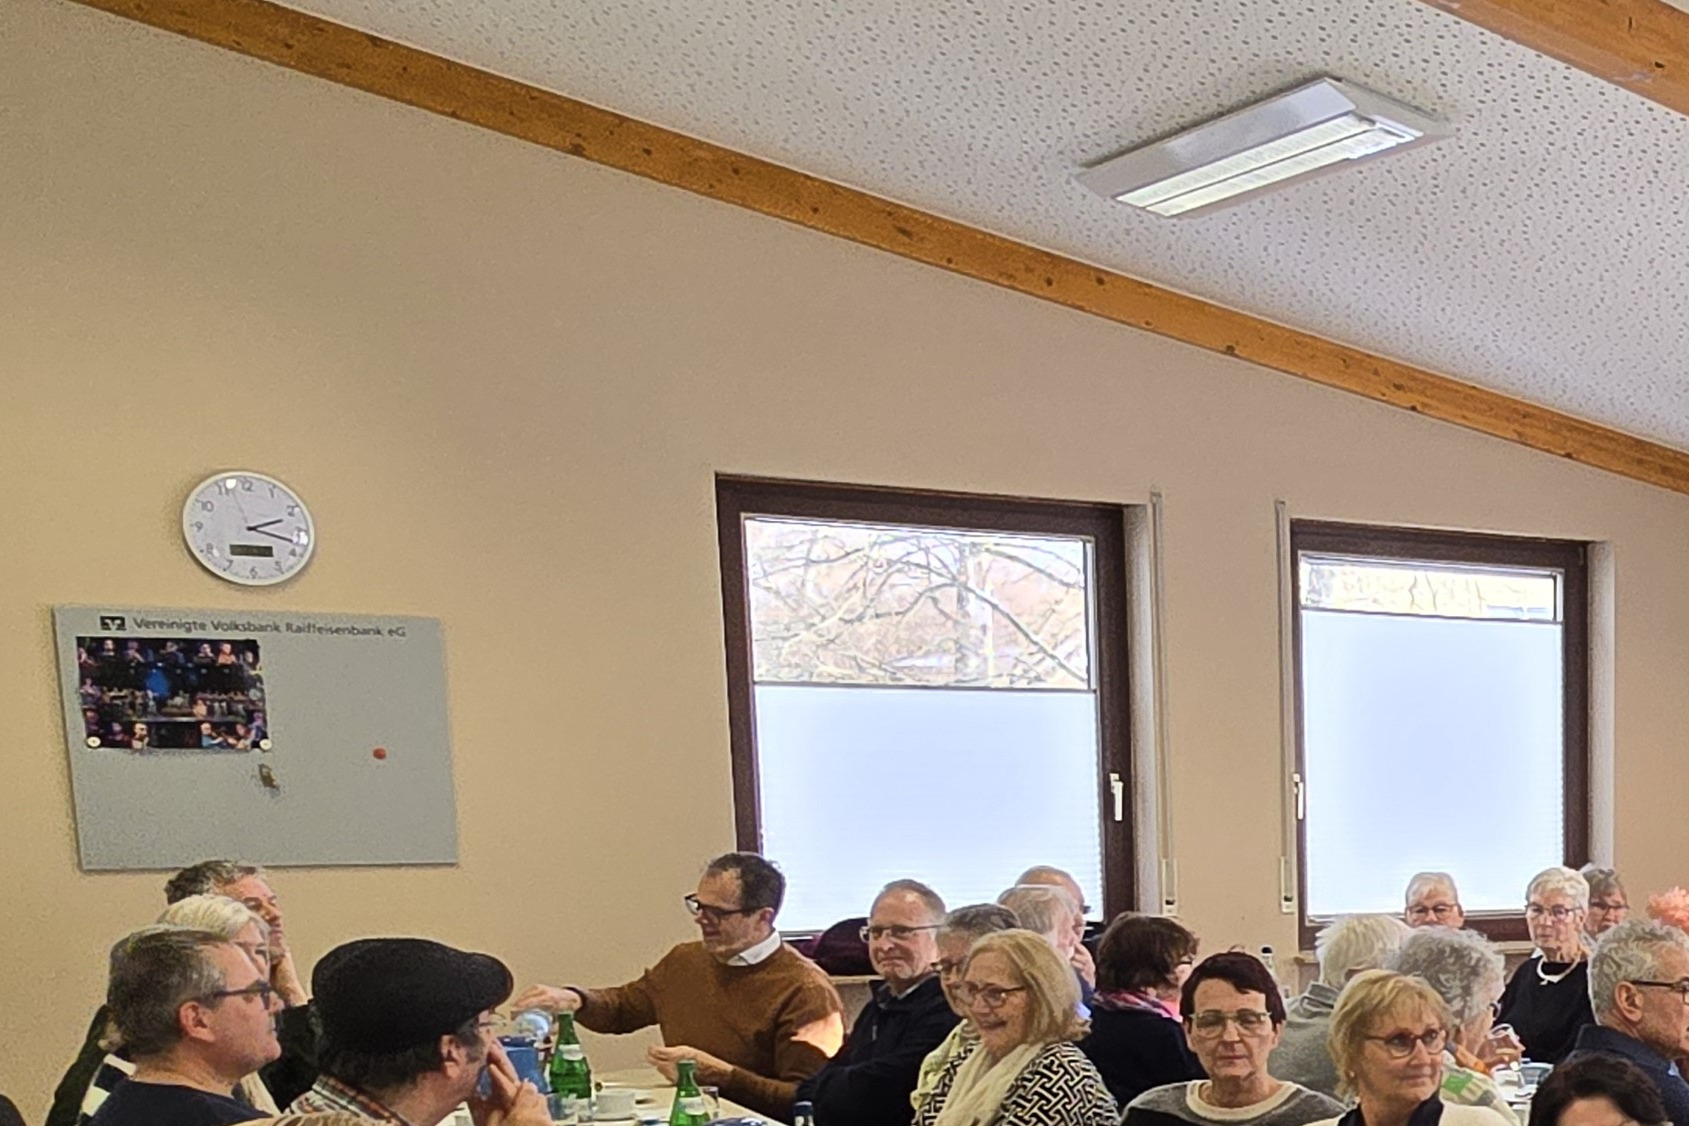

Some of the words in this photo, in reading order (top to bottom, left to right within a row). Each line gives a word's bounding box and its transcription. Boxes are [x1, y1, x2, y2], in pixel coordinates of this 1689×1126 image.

[241, 478, 254, 492] 12
[200, 500, 214, 512] 10
[286, 504, 299, 517] 2
[194, 521, 204, 532] 9
[249, 566, 258, 579] 6
[133, 617, 207, 633] Vereinigte
[210, 619, 281, 633] Volksbank
[285, 622, 383, 636] Raiffeisenbank
[388, 626, 406, 638] eG
